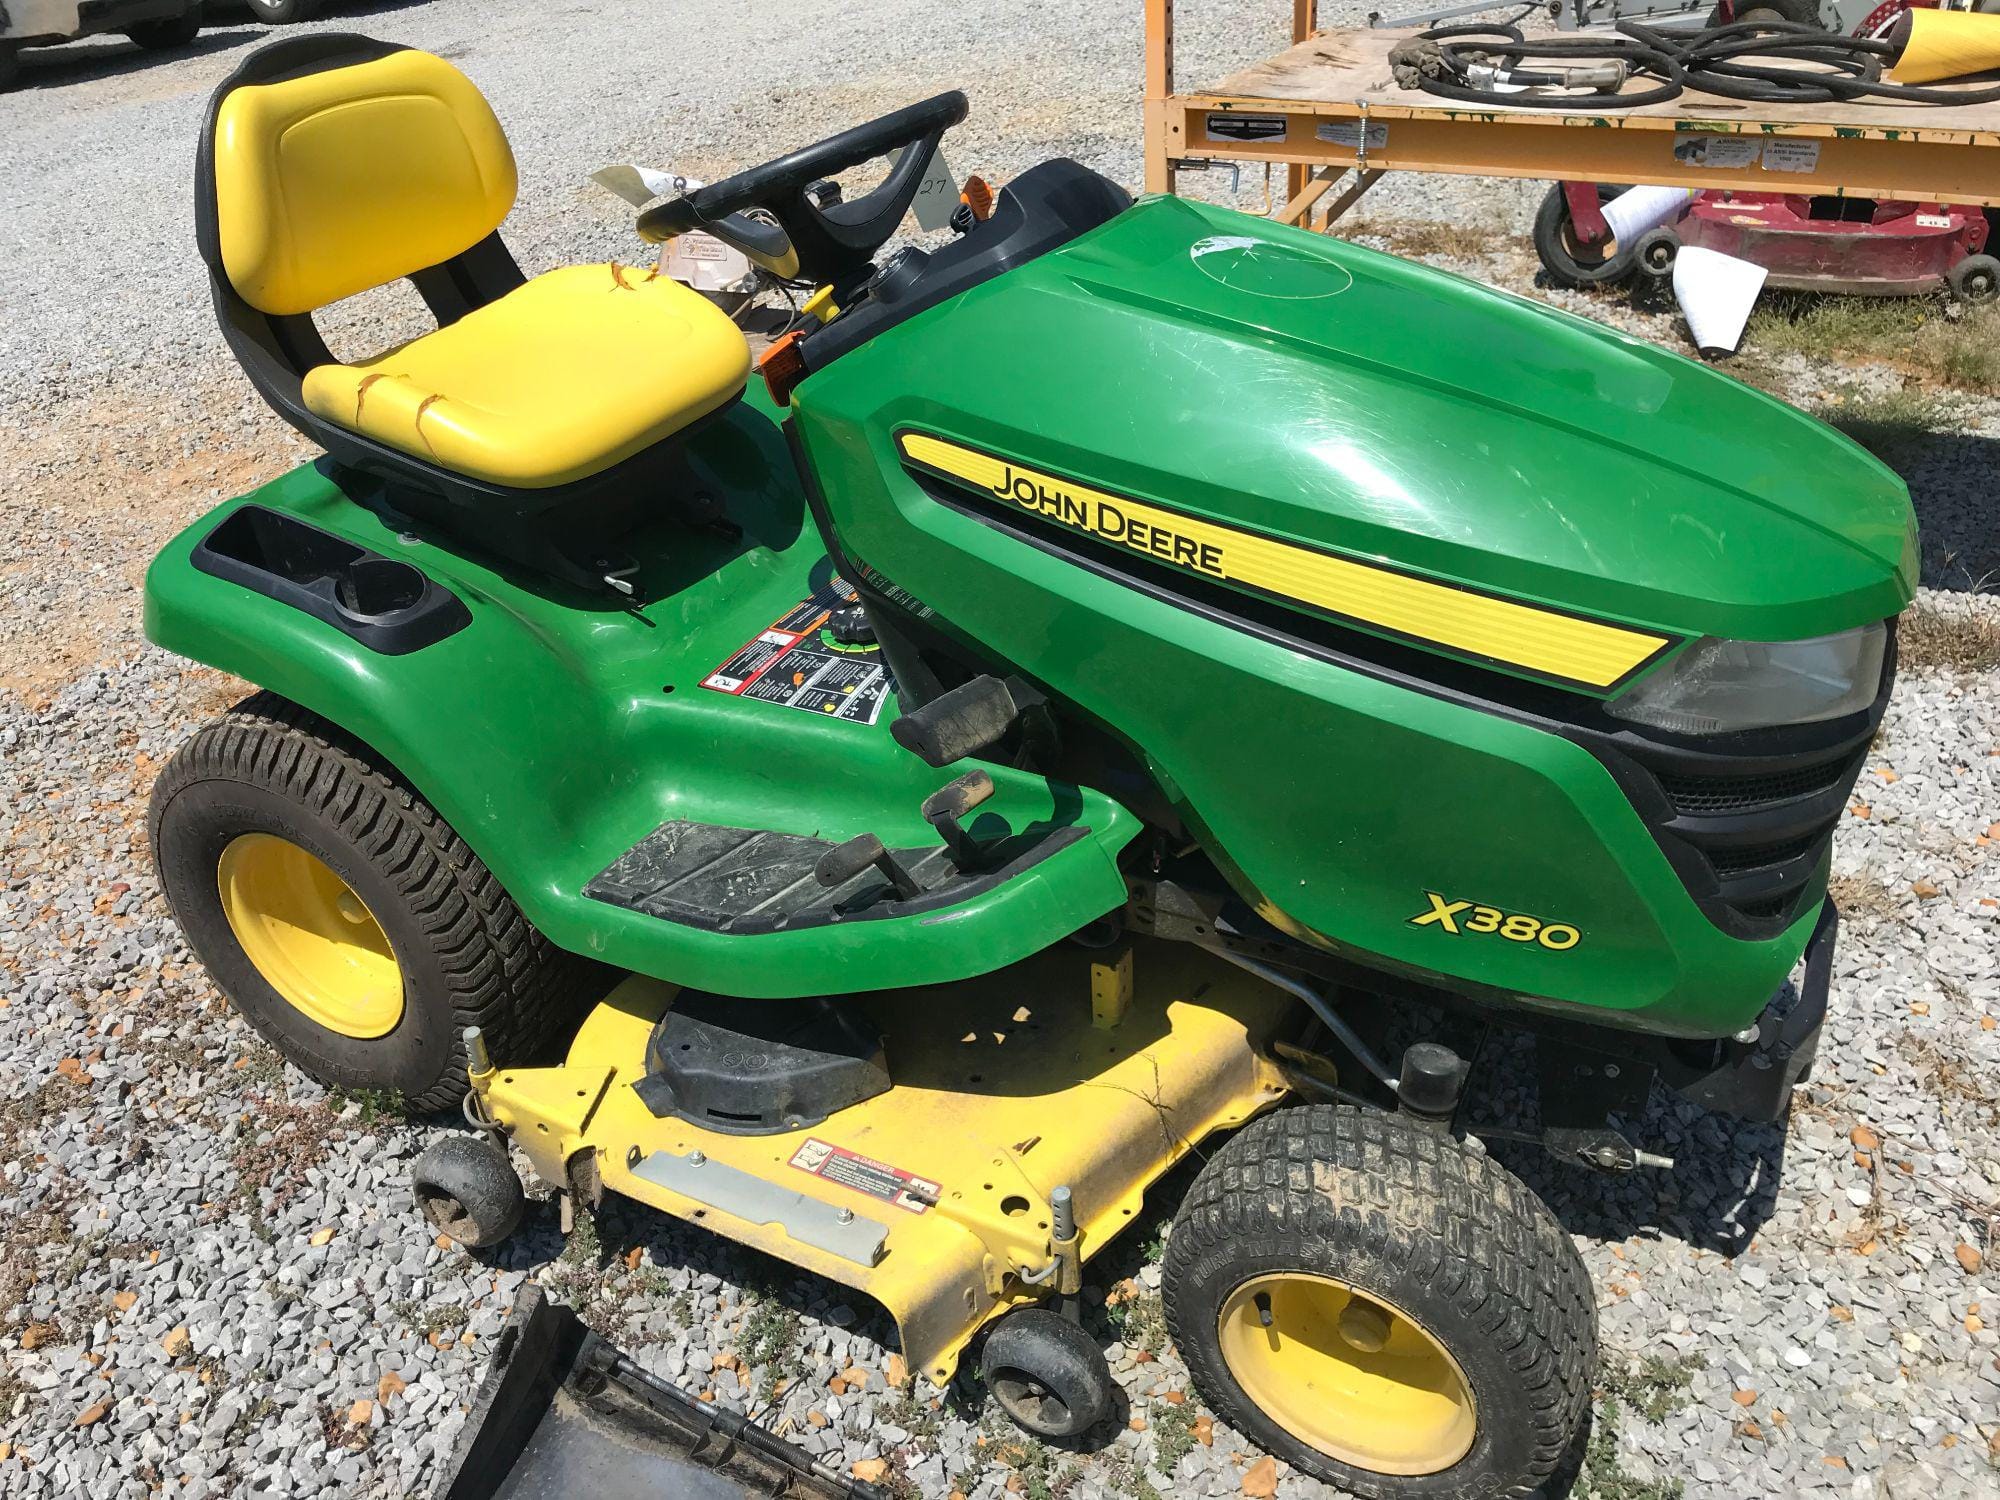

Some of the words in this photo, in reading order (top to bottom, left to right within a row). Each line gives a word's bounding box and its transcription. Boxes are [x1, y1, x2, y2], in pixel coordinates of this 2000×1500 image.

[920, 179, 947, 195] 27
[993, 466, 1088, 527] JOHN
[1097, 501, 1224, 575] DEERE
[1410, 891, 1581, 951] X380
[860, 1157, 896, 1174] DANGER
